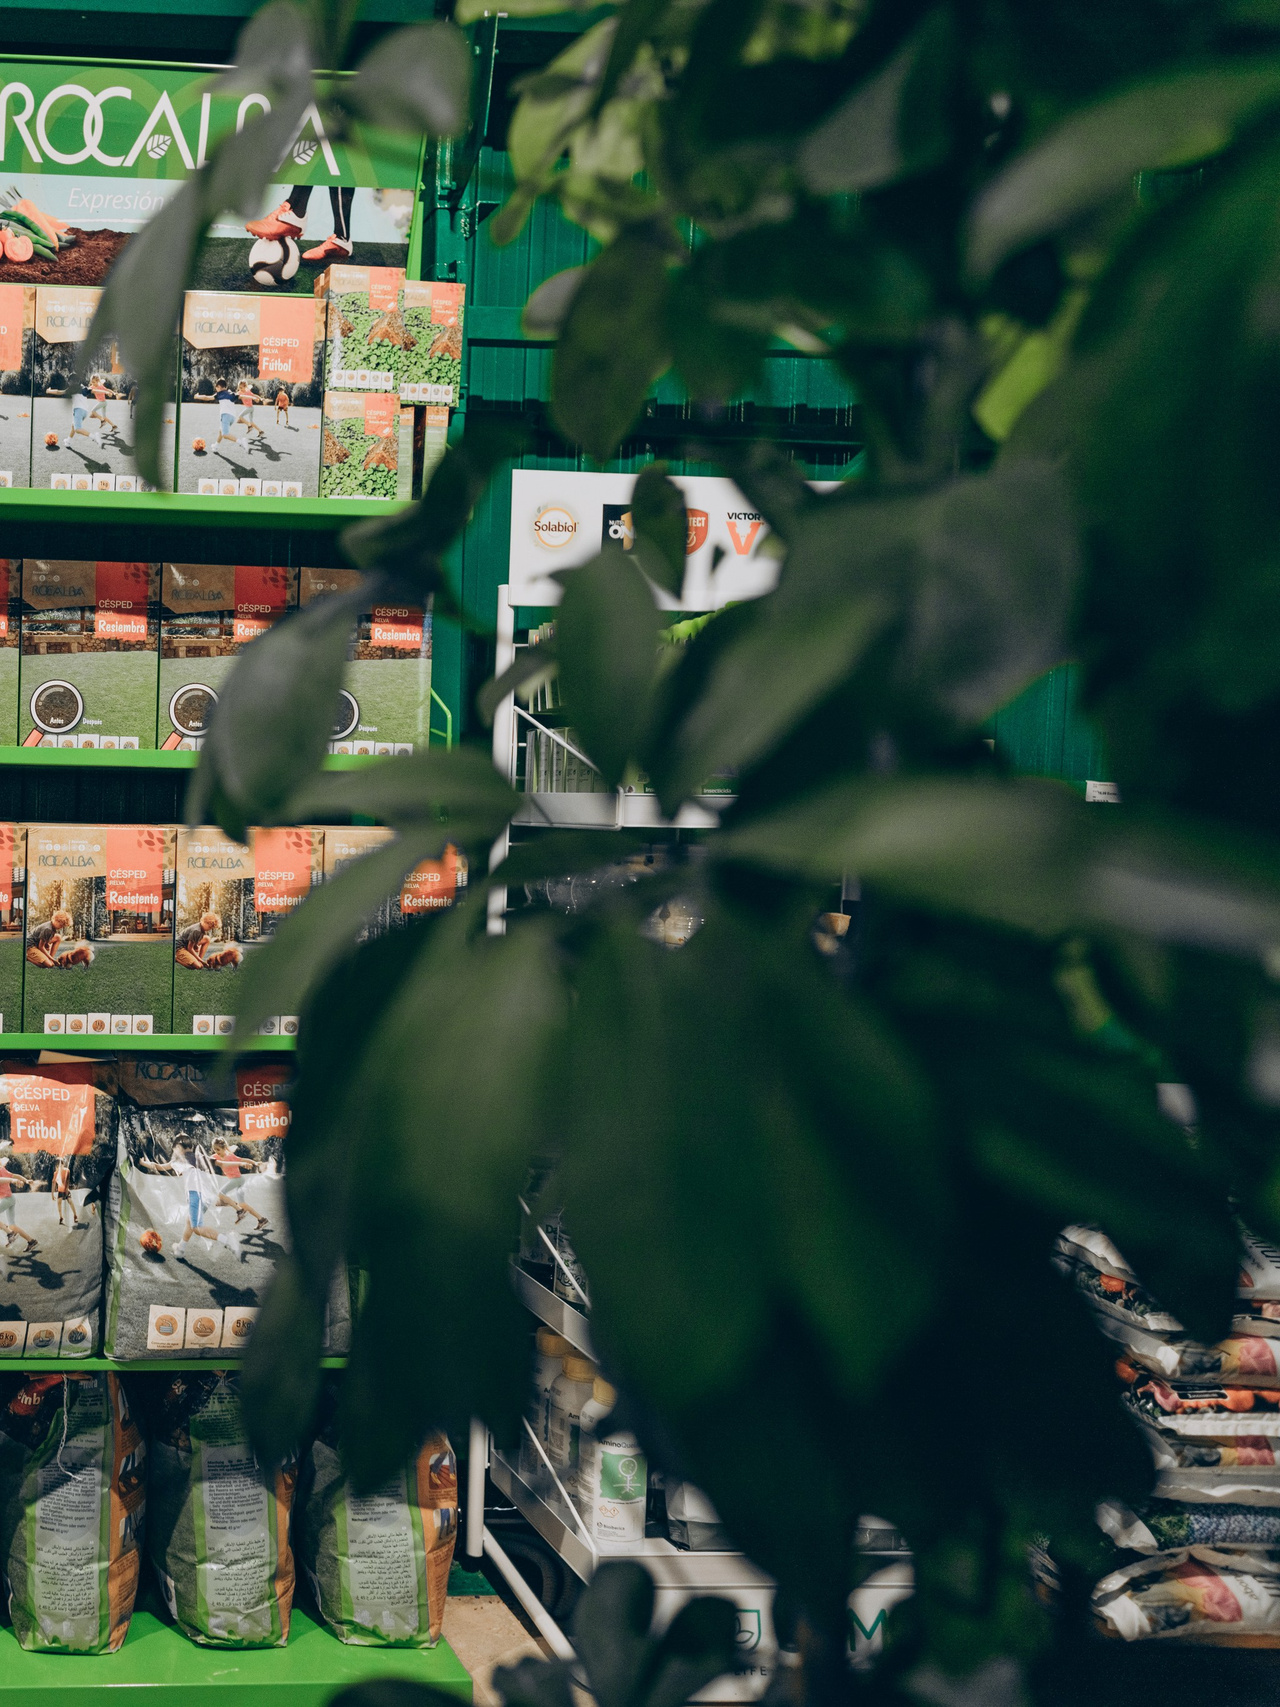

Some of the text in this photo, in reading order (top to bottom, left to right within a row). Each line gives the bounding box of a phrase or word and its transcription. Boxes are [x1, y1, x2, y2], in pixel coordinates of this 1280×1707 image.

[195, 322, 250, 335] ROCALBA
[263, 336, 299, 347] CÉSPED
[263, 357, 291, 372] Fútbol
[534, 521, 577, 533] Solabiol
[727, 512, 761, 522] VICTOR
[32, 585, 86, 597] ROCALBA
[98, 598, 132, 608] CÉSPED
[238, 603, 271, 613] CÉSPED
[375, 607, 408, 617] CÉSPED
[98, 620, 145, 633] Resiembra
[375, 628, 420, 641] Resiembra
[50, 717, 103, 726] Antes Después
[189, 720, 203, 729] Antes
[358, 725, 378, 733] Después
[39, 855, 96, 867] ROCALBA
[188, 857, 244, 868] ROCALBA
[110, 868, 146, 879] CÉSPED
[258, 870, 295, 880] CÉSPED
[405, 871, 440, 882] CÉSPED
[110, 891, 159, 905] Resistente
[404, 894, 452, 907] Resistente
[13, 1085, 70, 1101] CÉSPED
[243, 1101, 270, 1109] RELVA
[245, 1110, 292, 1130] Fútbol
[16, 1118, 61, 1140] Fútbol
[236, 1320, 240, 1328] 5
[0, 1332, 14, 1342] 5 kg
